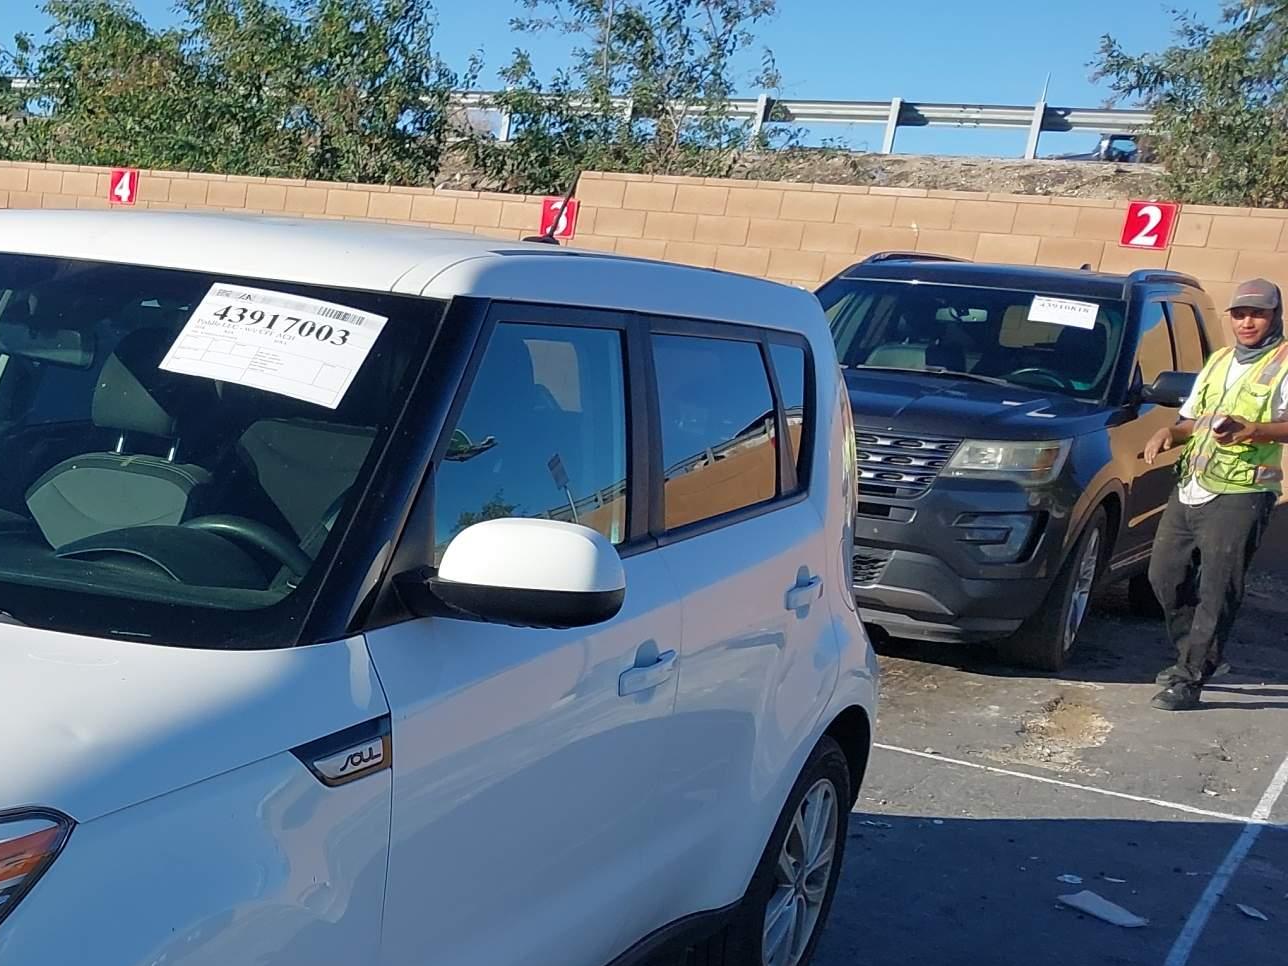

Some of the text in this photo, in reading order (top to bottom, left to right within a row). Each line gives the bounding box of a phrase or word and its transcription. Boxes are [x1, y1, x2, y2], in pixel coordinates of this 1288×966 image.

[114, 170, 131, 202] 4
[546, 199, 569, 235] 3
[1128, 204, 1163, 247] 2
[213, 305, 351, 346] 43917003
[339, 746, 381, 772] SOUL
